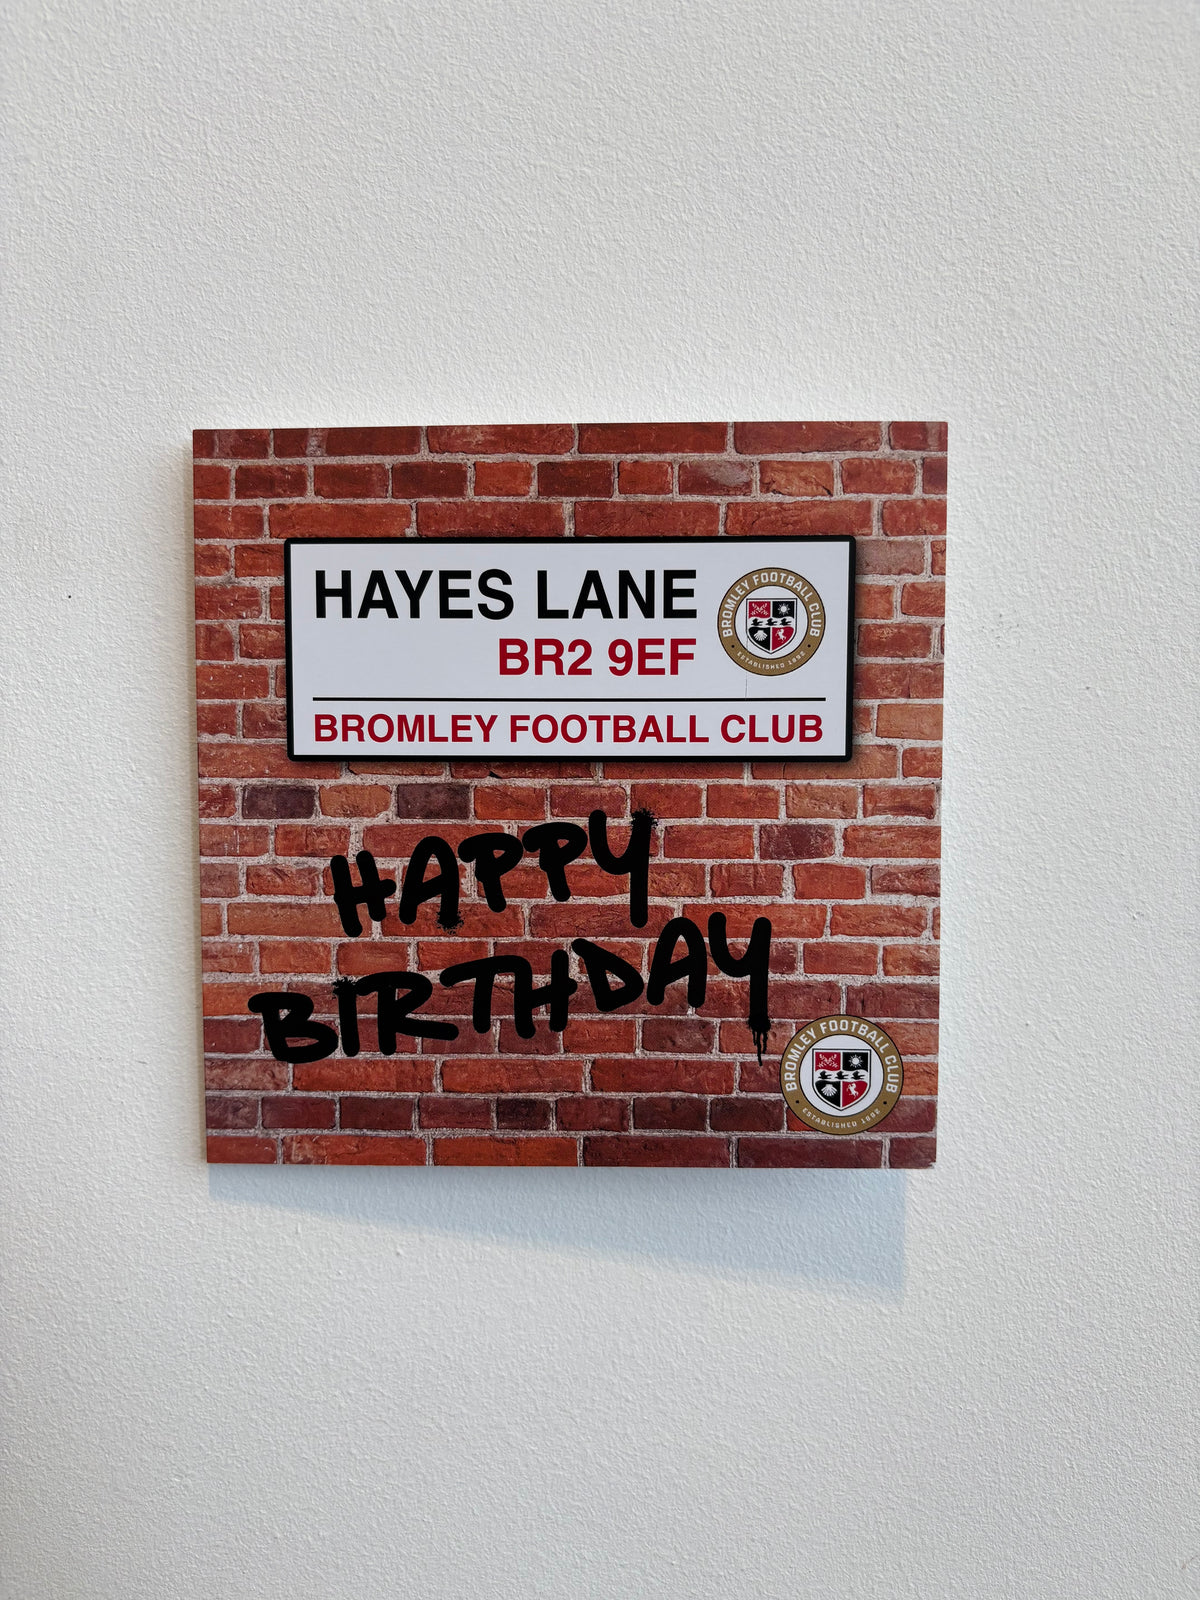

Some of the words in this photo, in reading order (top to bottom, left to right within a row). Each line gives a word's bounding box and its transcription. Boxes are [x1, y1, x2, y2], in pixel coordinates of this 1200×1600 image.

[315, 568, 514, 620] HAYES
[537, 570, 697, 619] LANE
[721, 579, 750, 638] BROMLEY
[752, 571, 813, 602] FOOTBALL
[809, 602, 822, 637] CLUB
[499, 638, 593, 676] BR2
[609, 638, 697, 676] 9EF
[315, 714, 497, 743] BROMLEY
[510, 714, 709, 743] FOOTBALL
[720, 714, 823, 743] CLUB
[331, 808, 658, 937] HAPPY
[248, 912, 772, 1065] BIRTHDAY
[784, 1027, 816, 1092] BROMLEY
[820, 1019, 890, 1054] FOOTBALL
[884, 1055, 900, 1094] CLUB
[802, 1107, 858, 1129] ESTABLISHED
